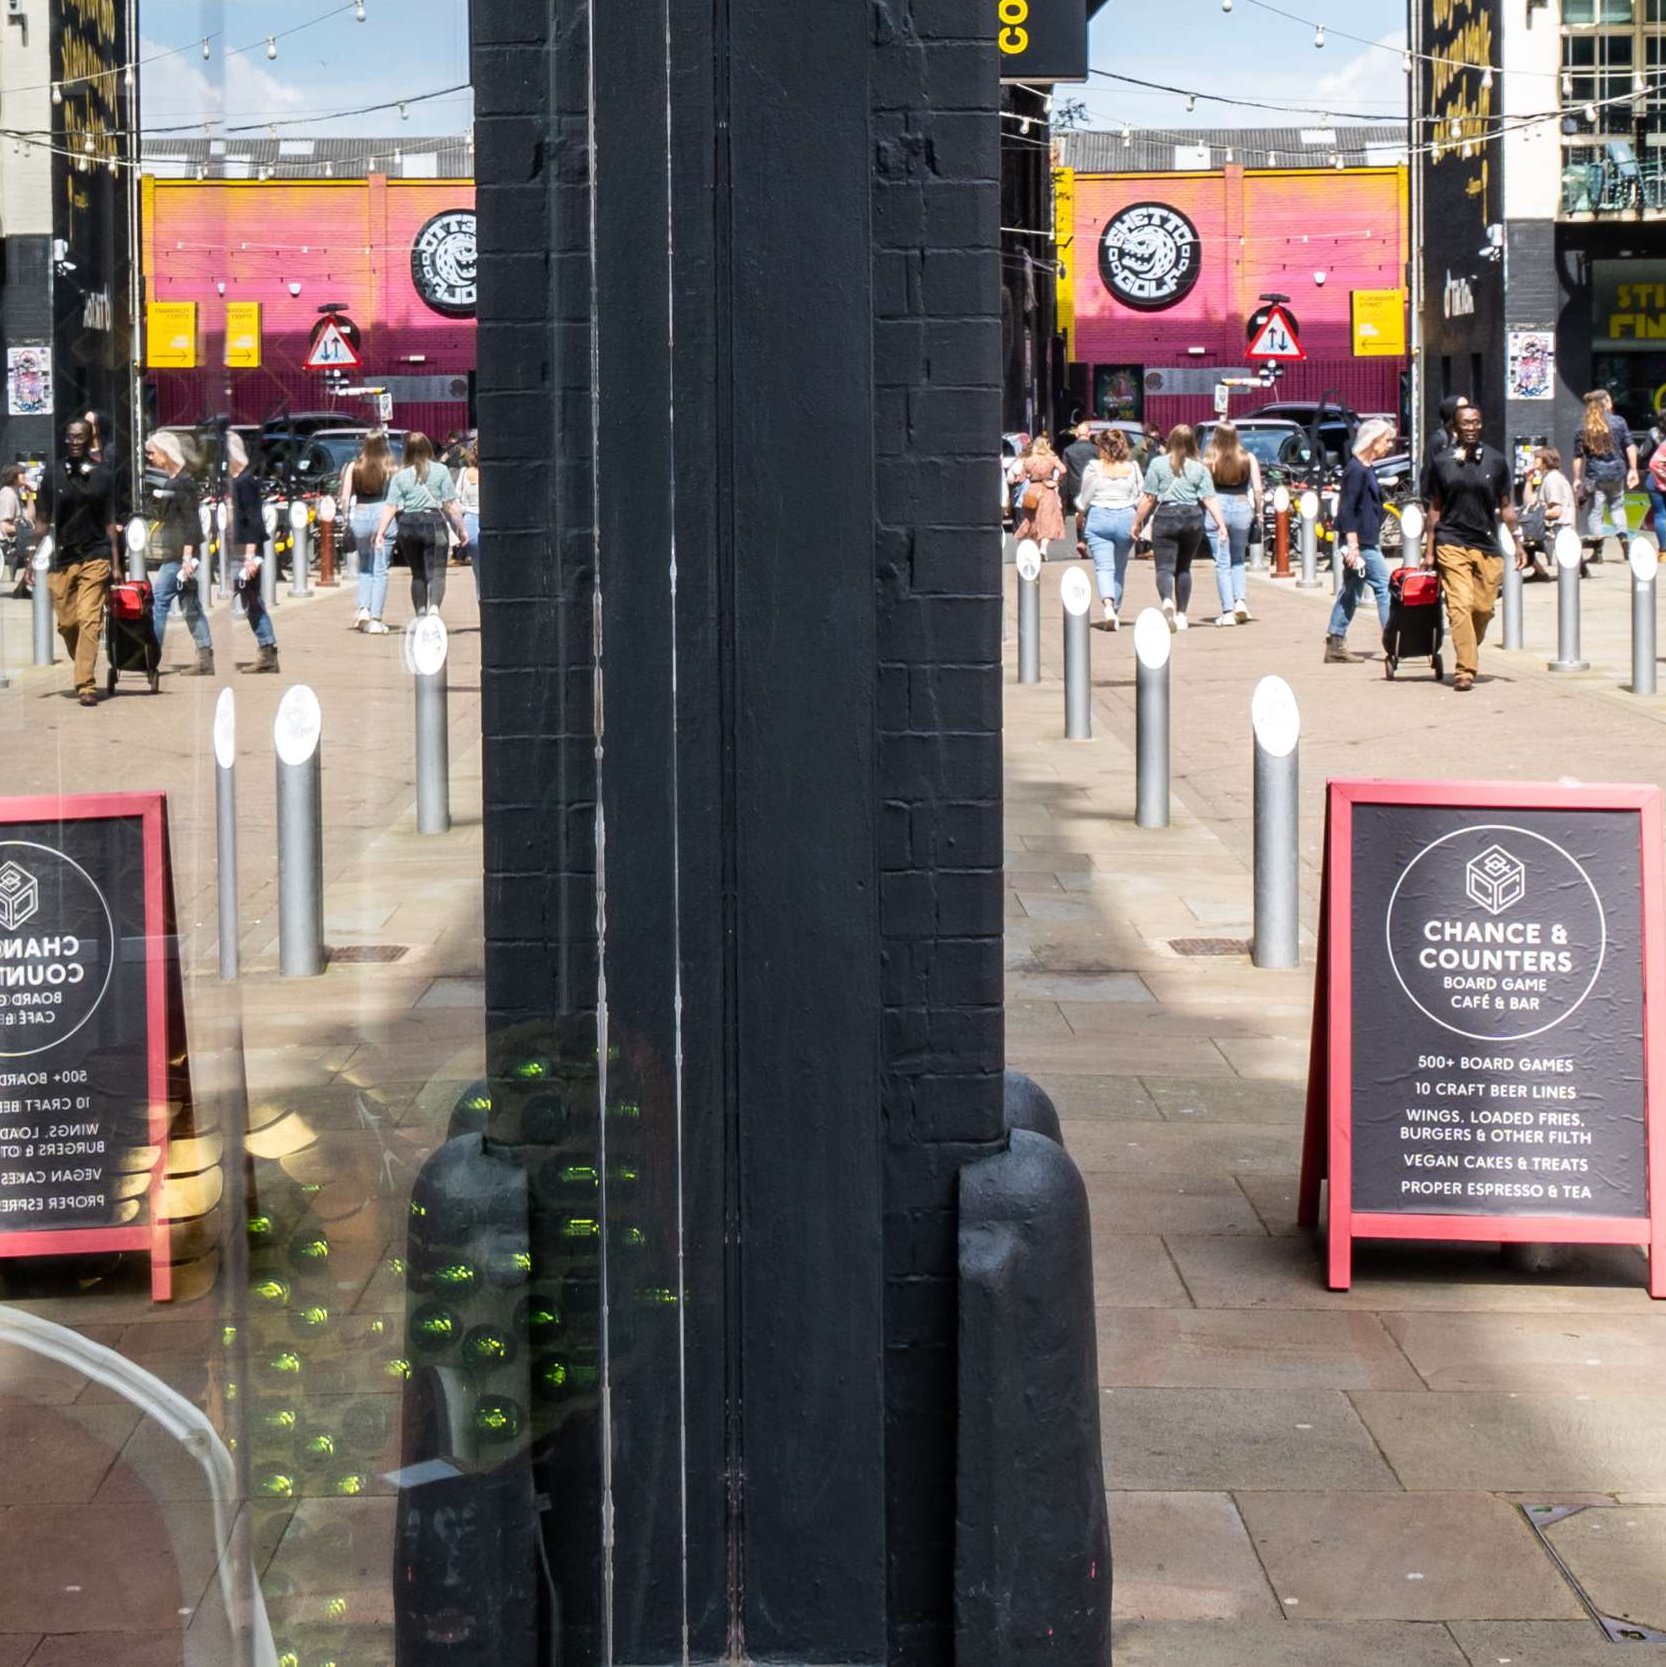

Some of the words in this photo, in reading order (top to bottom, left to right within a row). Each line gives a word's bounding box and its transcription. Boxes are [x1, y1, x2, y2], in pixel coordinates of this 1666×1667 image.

[1104, 207, 1194, 246] GHETTO
[1114, 268, 1178, 298] GOLF
[1423, 920, 1541, 944] CHANCE
[1552, 924, 1568, 944] &
[1419, 948, 1572, 973] COUNTERS
[1443, 976, 1497, 992] BOARD
[1501, 977, 1547, 992] GAME
[1451, 993, 1490, 1010] CAFÉ
[1495, 997, 1505, 1010] &
[1509, 996, 1540, 1011] BAR
[1418, 1055, 1455, 1070] 500+
[1460, 1056, 1515, 1071] BOARD
[1519, 1058, 1574, 1073] GAMES
[1415, 1082, 1431, 1095] 10
[1435, 1082, 1484, 1097] CRAFT
[1489, 1083, 1528, 1098] BEER
[1532, 1085, 1576, 1100] LINES
[1470, 1110, 1533, 1125] LOADED
[1400, 1127, 1472, 1142] BURGERS
[1476, 1128, 1486, 1142] &
[1490, 1128, 1544, 1144] OTHER
[1548, 1129, 1592, 1145] FILTH
[1403, 1154, 1459, 1169] VEGAN
[1464, 1155, 1513, 1170] CAKES
[1518, 1156, 1528, 1170] &
[1532, 1156, 1589, 1172] TREATS
[1401, 1181, 1462, 1195] PROPER
[1467, 1182, 1543, 1198] ESPRESSO
[1548, 1184, 1558, 1198] &
[1562, 1185, 1592, 1199] TEA
